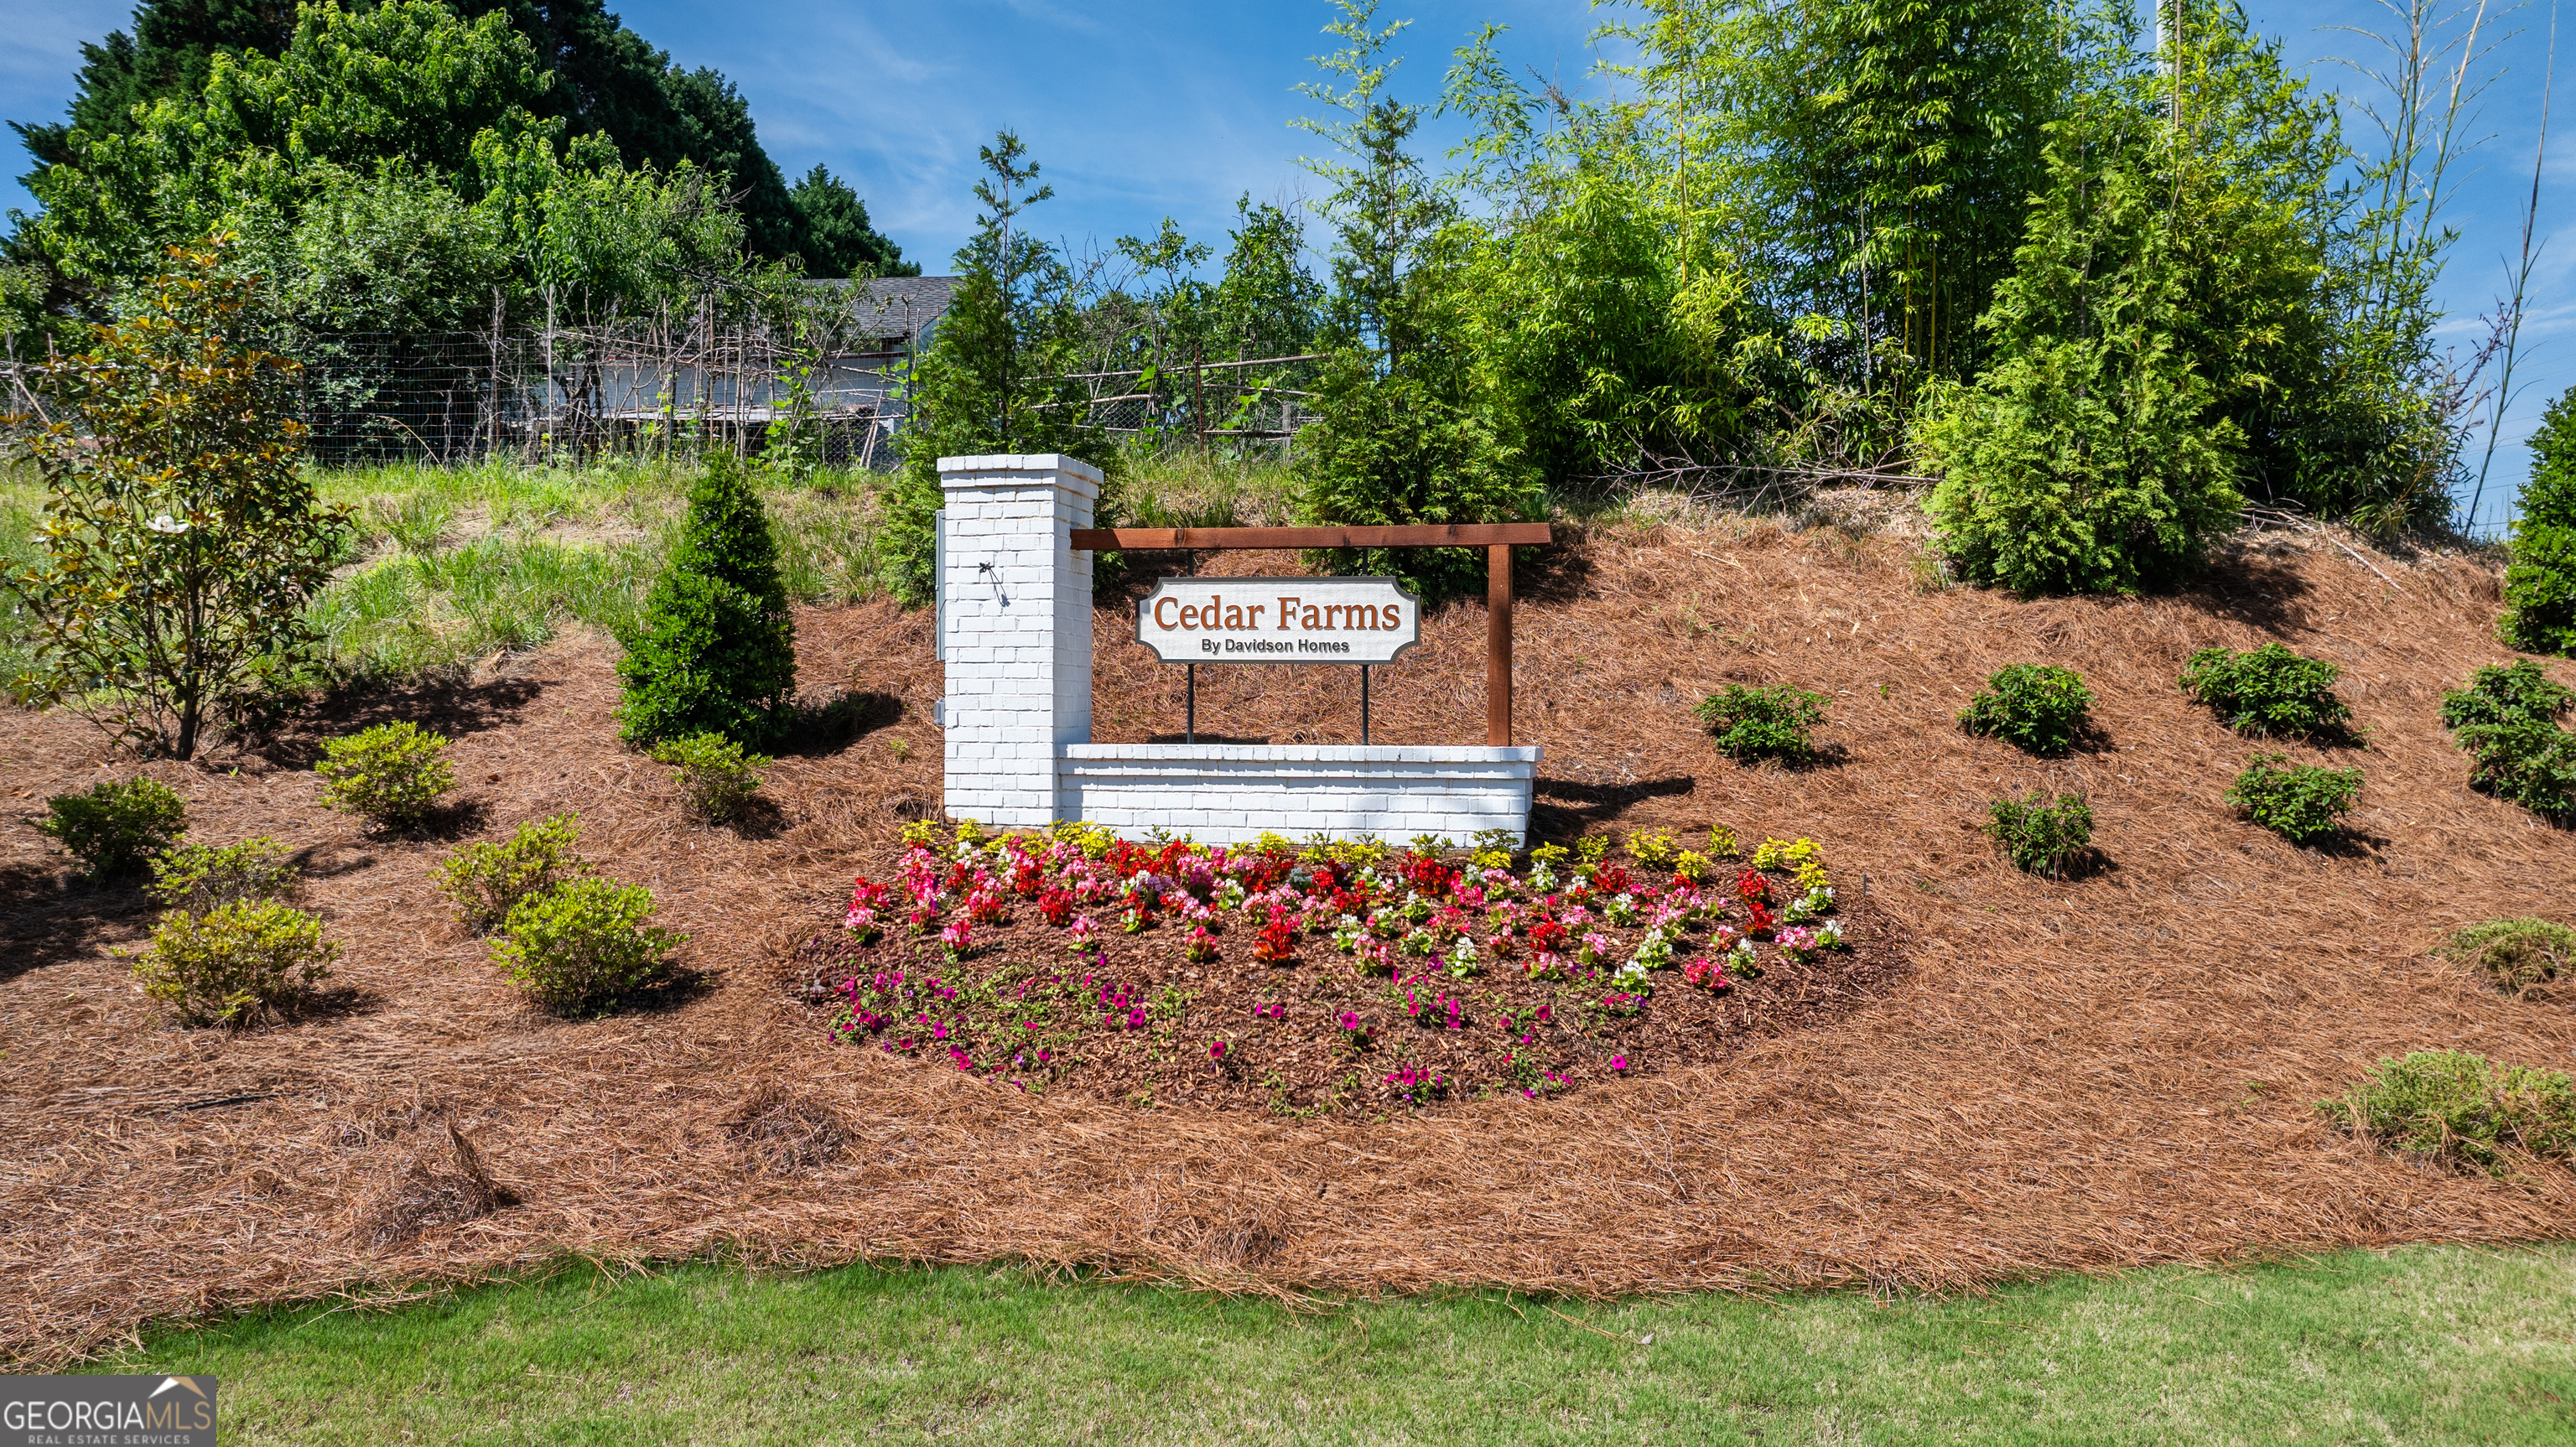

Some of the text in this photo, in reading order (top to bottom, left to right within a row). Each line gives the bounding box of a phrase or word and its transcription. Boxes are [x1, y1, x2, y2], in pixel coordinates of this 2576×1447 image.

[1154, 594, 1400, 630] Cedar Farms
[1202, 639, 1349, 655] By Davidson Homes
